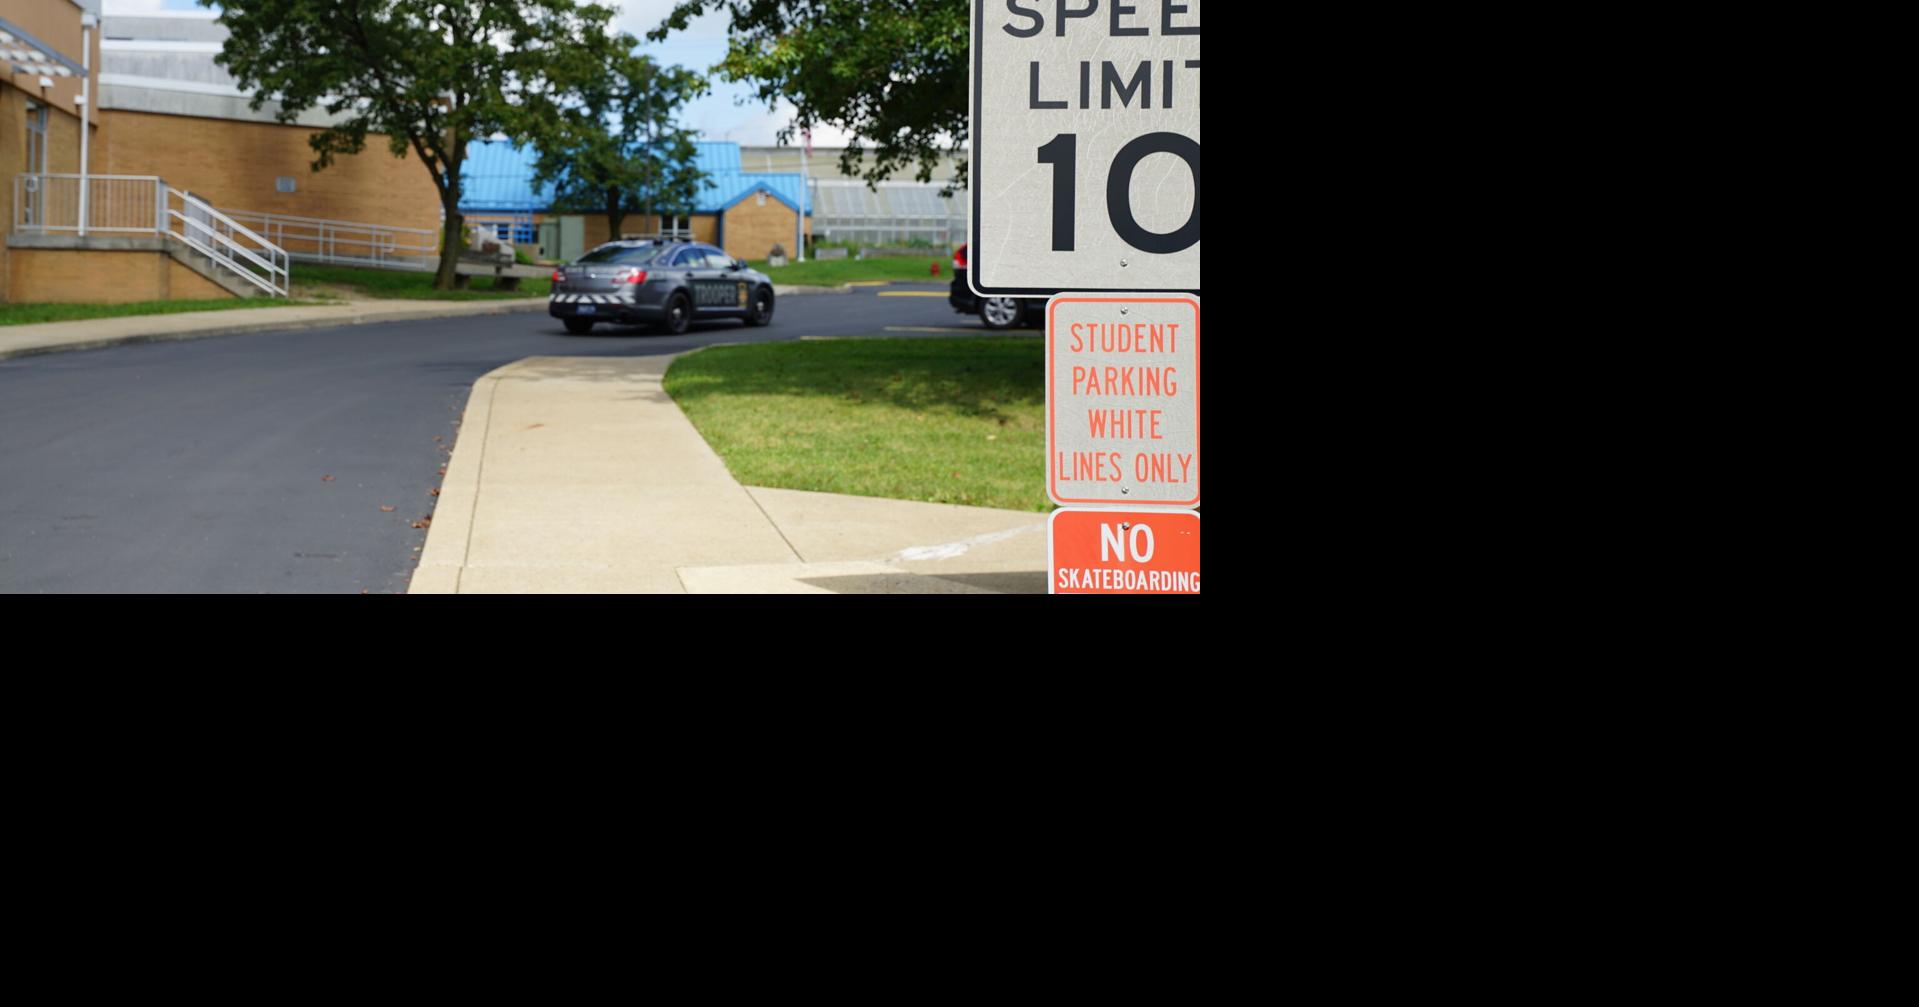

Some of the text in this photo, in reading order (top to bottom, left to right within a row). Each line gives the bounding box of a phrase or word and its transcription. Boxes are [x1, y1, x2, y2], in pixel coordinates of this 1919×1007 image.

[1037, 131, 1200, 254] 10
[694, 284, 736, 305] TROOPER
[1070, 323, 1179, 353] STUDENT
[1072, 366, 1177, 397] PARKING
[1088, 409, 1163, 439] WHITE
[1058, 451, 1192, 483] LINES ONLY
[1100, 522, 1155, 563] NO
[1058, 567, 1200, 592] SKATEBOARDING
